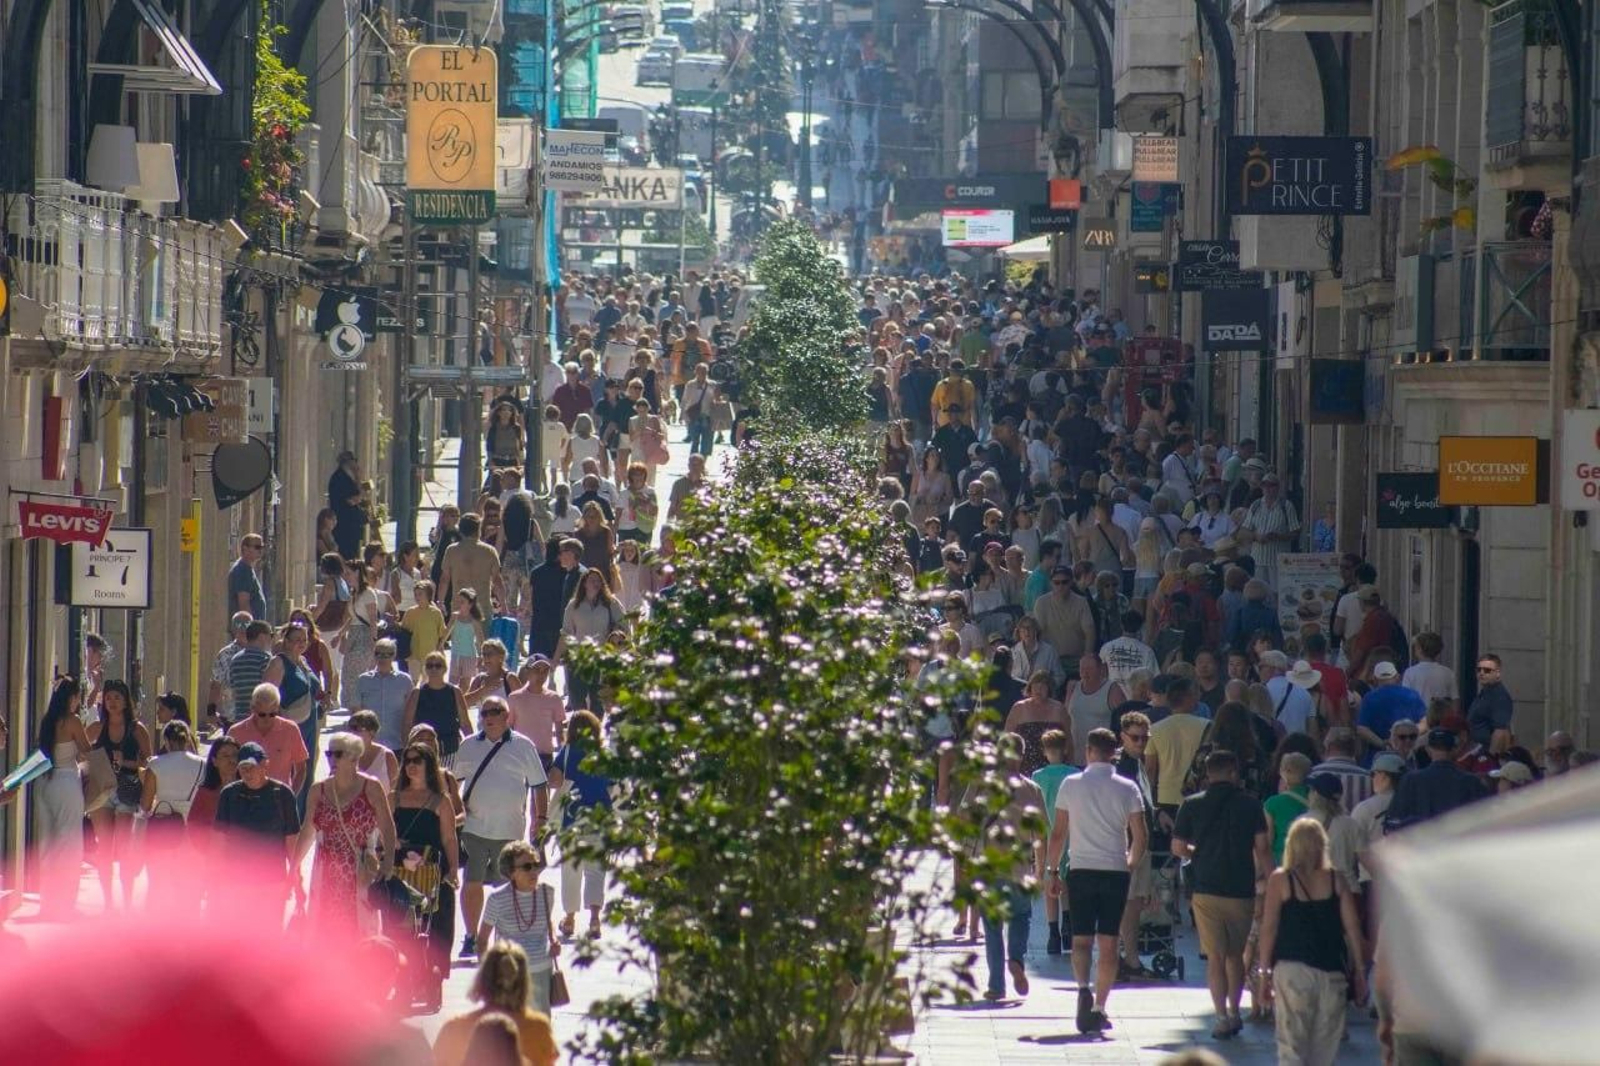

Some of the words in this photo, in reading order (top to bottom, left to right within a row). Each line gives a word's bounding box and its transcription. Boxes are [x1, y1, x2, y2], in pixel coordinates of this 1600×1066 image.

[441, 51, 463, 70] EL
[412, 81, 492, 101] PORTAL
[550, 160, 603, 170] ANDAMIOS
[592, 177, 667, 200] ANKA
[415, 194, 487, 218] RESIDENCIA
[1084, 230, 1115, 246] ZARA
[1448, 461, 1530, 475] L'OCCITANE
[1414, 493, 1440, 509] bonit
[94, 589, 126, 599] Rooms
